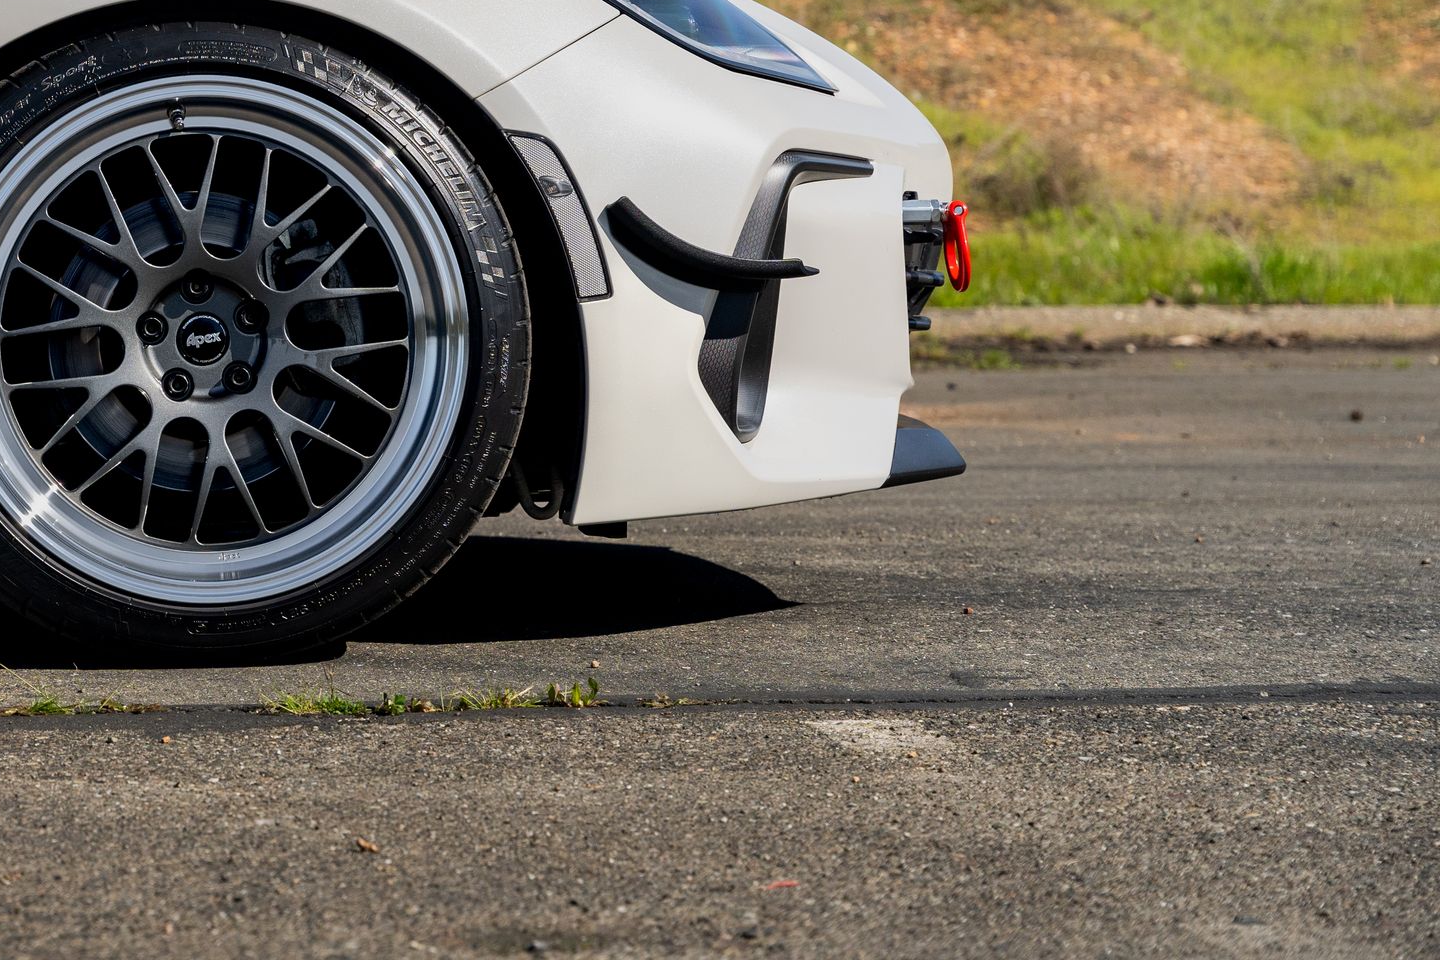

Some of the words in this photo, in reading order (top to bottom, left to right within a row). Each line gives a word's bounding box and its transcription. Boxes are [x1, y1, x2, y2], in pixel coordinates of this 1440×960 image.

[40, 55, 97, 92] Sport
[381, 101, 487, 232] MICHELIN
[186, 332, 221, 348] Apex
[500, 337, 510, 388] OUTSIDE
